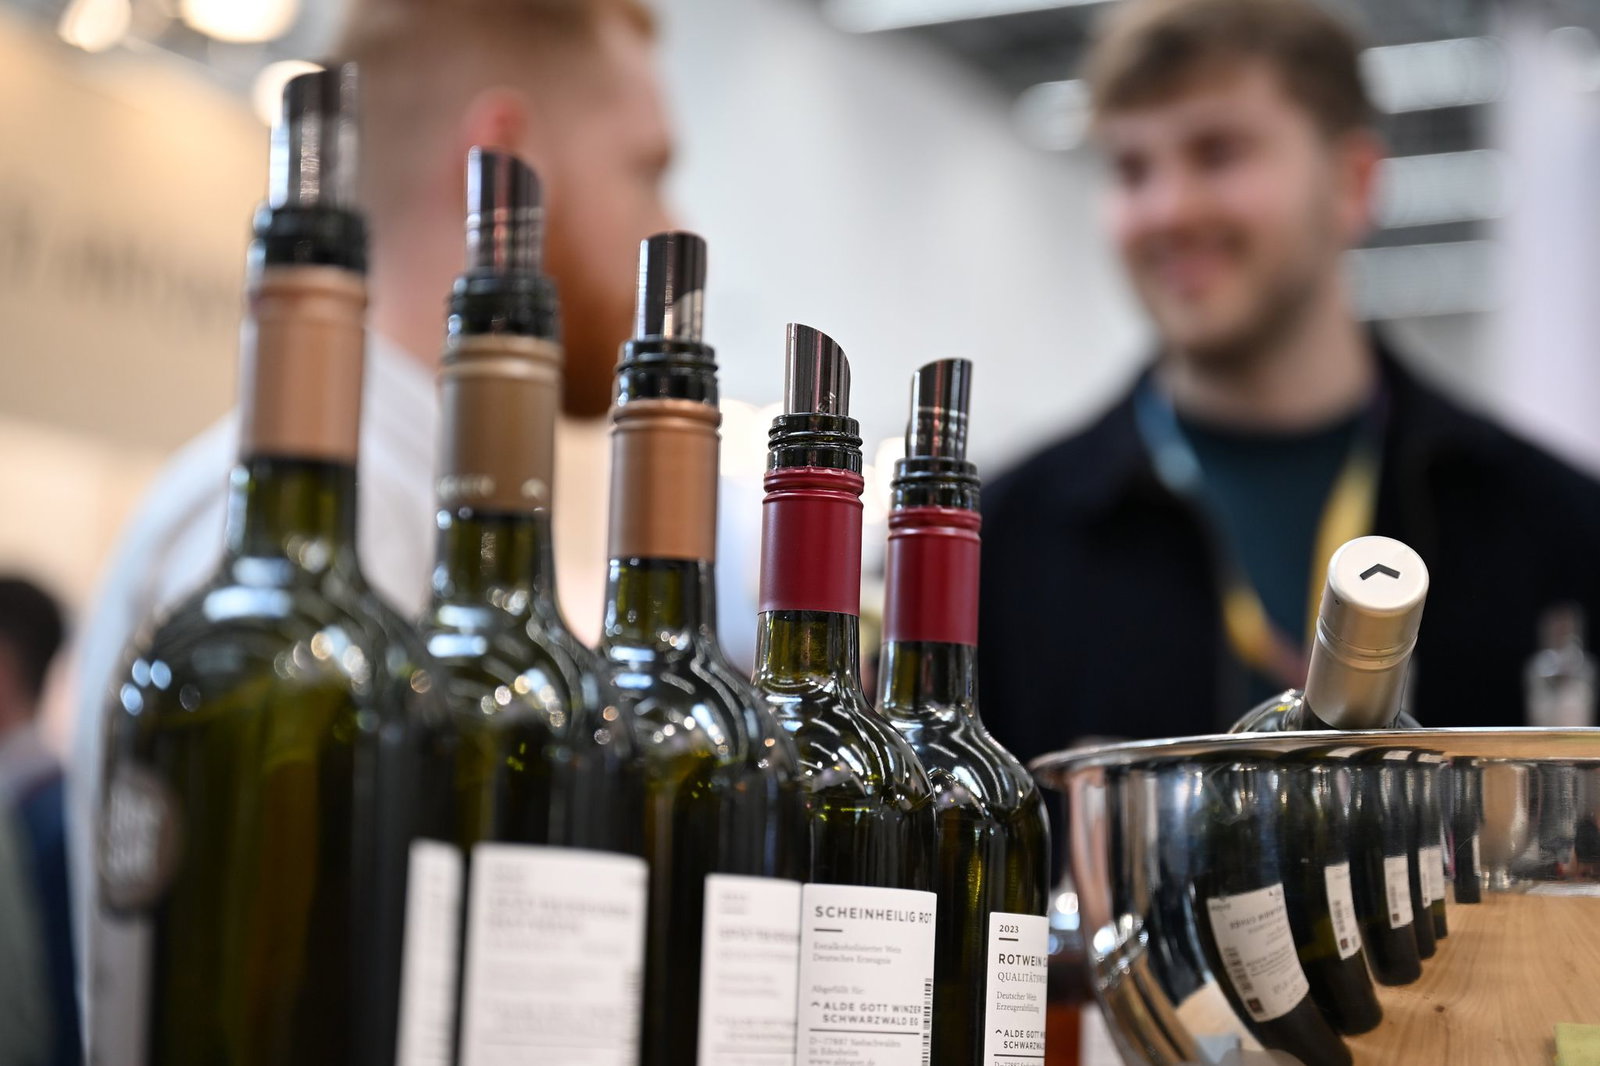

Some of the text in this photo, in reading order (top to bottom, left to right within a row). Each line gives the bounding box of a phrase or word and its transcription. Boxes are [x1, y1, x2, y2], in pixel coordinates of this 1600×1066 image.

[815, 906, 916, 923] SCHEINHEILIG
[999, 925, 1020, 933] 2023
[998, 953, 1042, 967] ROTWEIN
[996, 991, 1026, 1000] Deutscher
[823, 1002, 922, 1014] ALDE GOTT WINZER
[822, 1014, 919, 1026] SCHWARZWALD EG
[1003, 1029, 1024, 1038] ALDE
